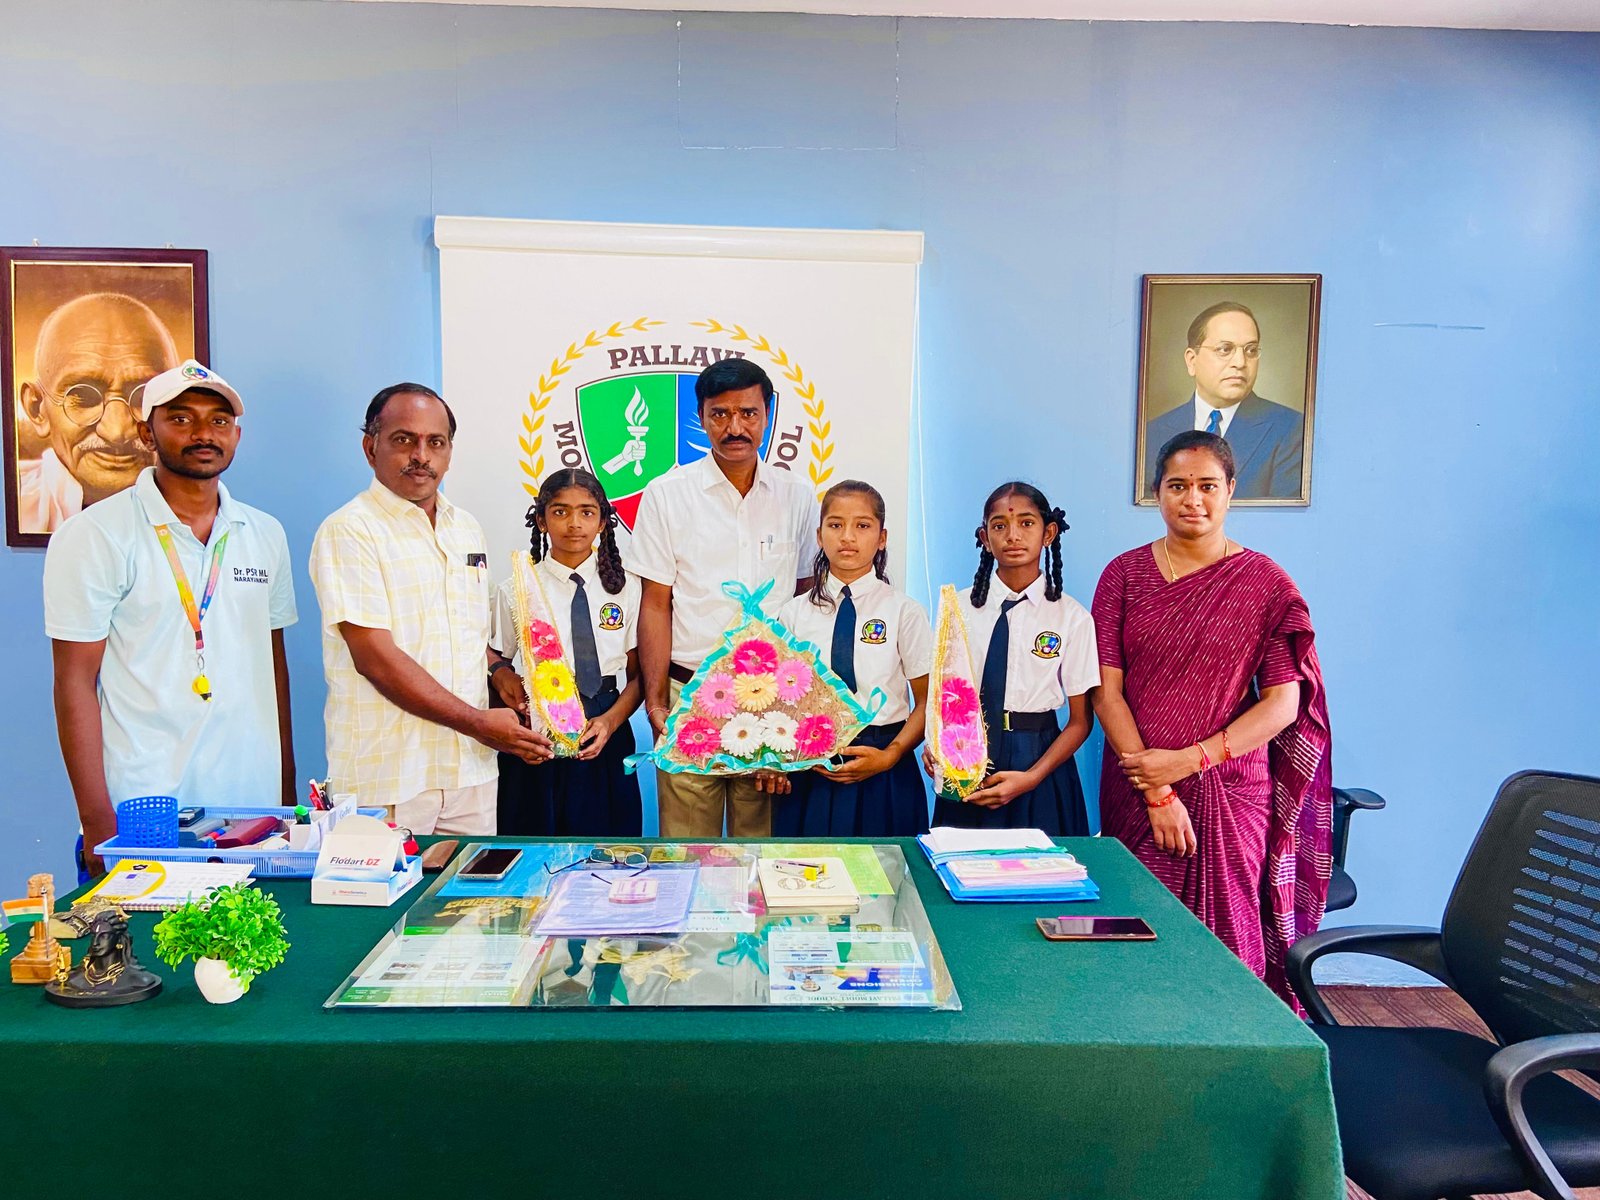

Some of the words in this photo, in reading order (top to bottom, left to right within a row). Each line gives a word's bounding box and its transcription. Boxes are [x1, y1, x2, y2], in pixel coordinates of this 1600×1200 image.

[552, 420, 586, 471] MO
[233, 567, 244, 575] Dr.
[245, 568, 258, 576] PSR
